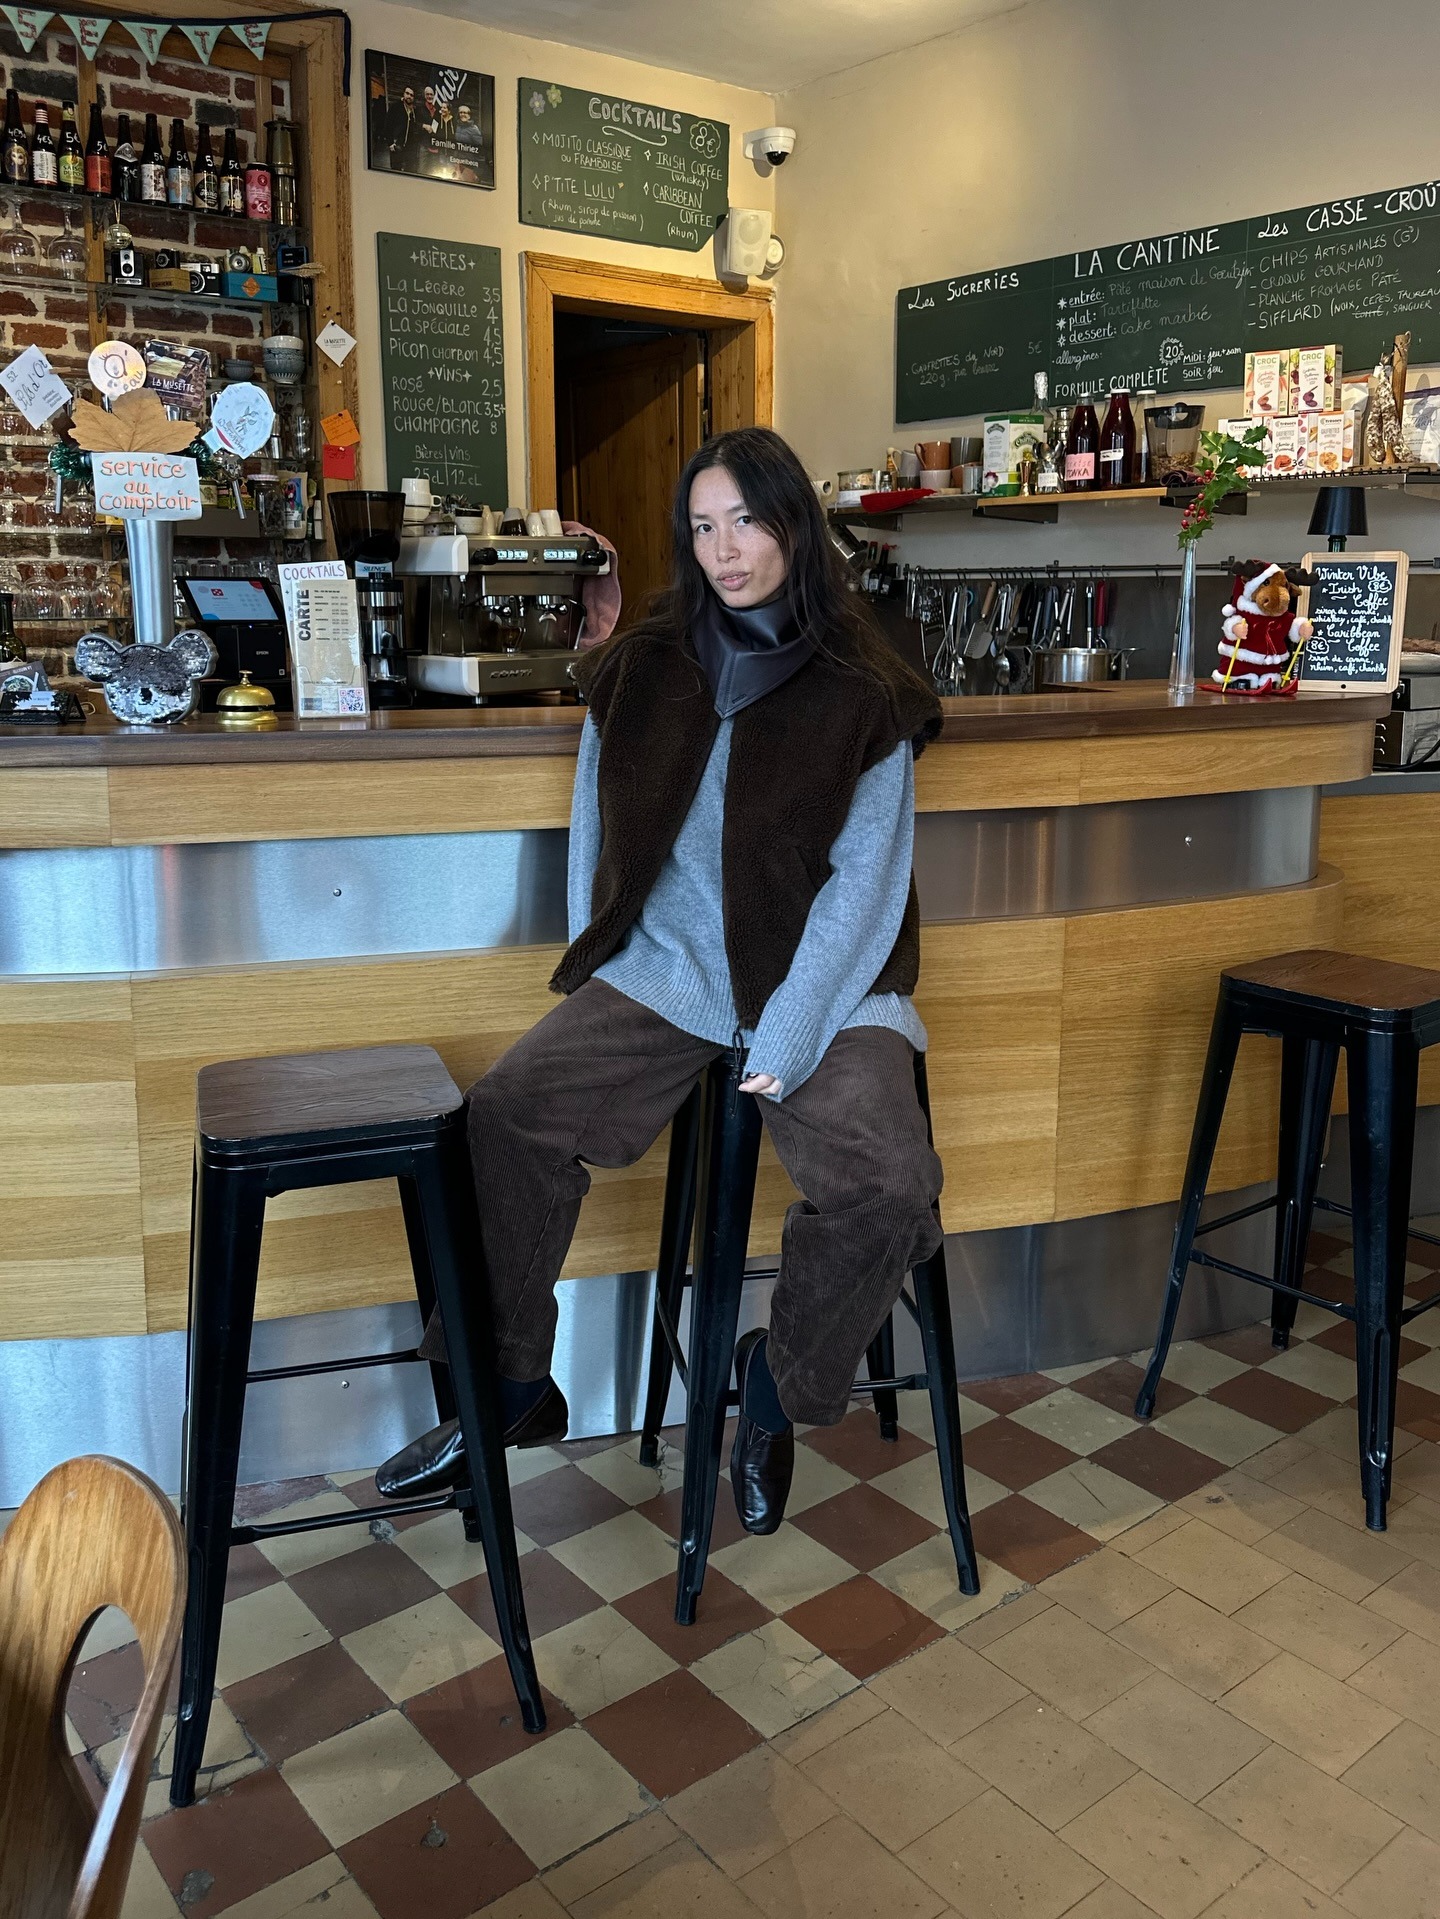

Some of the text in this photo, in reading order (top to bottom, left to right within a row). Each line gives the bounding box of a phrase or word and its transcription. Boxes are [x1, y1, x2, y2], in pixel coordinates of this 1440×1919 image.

[588, 97, 682, 135] COCKTAILS
[431, 137, 479, 154] Famille Thiriez
[542, 132, 632, 159] MOJITO CLASSIQUE
[574, 154, 623, 172] FRAMBOISE
[655, 151, 723, 181] IRISH COFFEE
[584, 180, 615, 201] LULU
[652, 183, 703, 210] CARIBBEAN
[567, 215, 577, 225] de
[578, 205, 599, 221] sirop
[600, 206, 611, 217] de
[679, 210, 714, 228] COFFEE
[667, 221, 699, 244] (Rhum)
[1257, 216, 1289, 239] Les
[1073, 228, 1221, 279] LA CANTINE
[1259, 247, 1308, 274] CHIPS
[1314, 233, 1387, 261] ARTISANALES
[1260, 254, 1384, 290] CROQUE GOURMAND
[907, 271, 1020, 310] Les SUCRERIES
[1068, 287, 1106, 308] entrée:
[1108, 280, 1132, 296] Pâté
[1138, 274, 1186, 292] maison
[1190, 268, 1208, 286] de
[1258, 288, 1306, 308] PLANCHE
[1310, 278, 1362, 298] FROMAGE
[486, 306, 499, 325] 4
[1068, 297, 1162, 332] plat: Tartiflette
[1258, 303, 1322, 329] SIFFLARD
[1069, 322, 1118, 345] dessert:
[1120, 316, 1153, 335] Cake
[1027, 340, 1043, 355] 5€
[911, 354, 961, 375] GAUFRETTES
[983, 345, 1005, 358] NORD
[1055, 366, 1169, 398] FORMULE COMPLÈTE
[1206, 364, 1224, 380] jeu
[152, 377, 195, 393] LA MUSETTE
[481, 378, 503, 399] 2,5
[490, 421, 498, 435] 8
[415, 443, 444, 460] Bières
[100, 456, 187, 479] service
[123, 480, 152, 495] au
[283, 563, 345, 581] COCKTAILS
[1315, 565, 1388, 581] Winter Vibe
[1328, 582, 1363, 595] Irish
[1338, 606, 1348, 615] de
[1353, 592, 1389, 611] Coffee
[296, 589, 311, 641] CARTE
[1326, 624, 1381, 638] Caribbean
[1311, 638, 1381, 657] 8€ Coffee
[1331, 655, 1343, 663] de
[490, 668, 533, 680] CONTI
